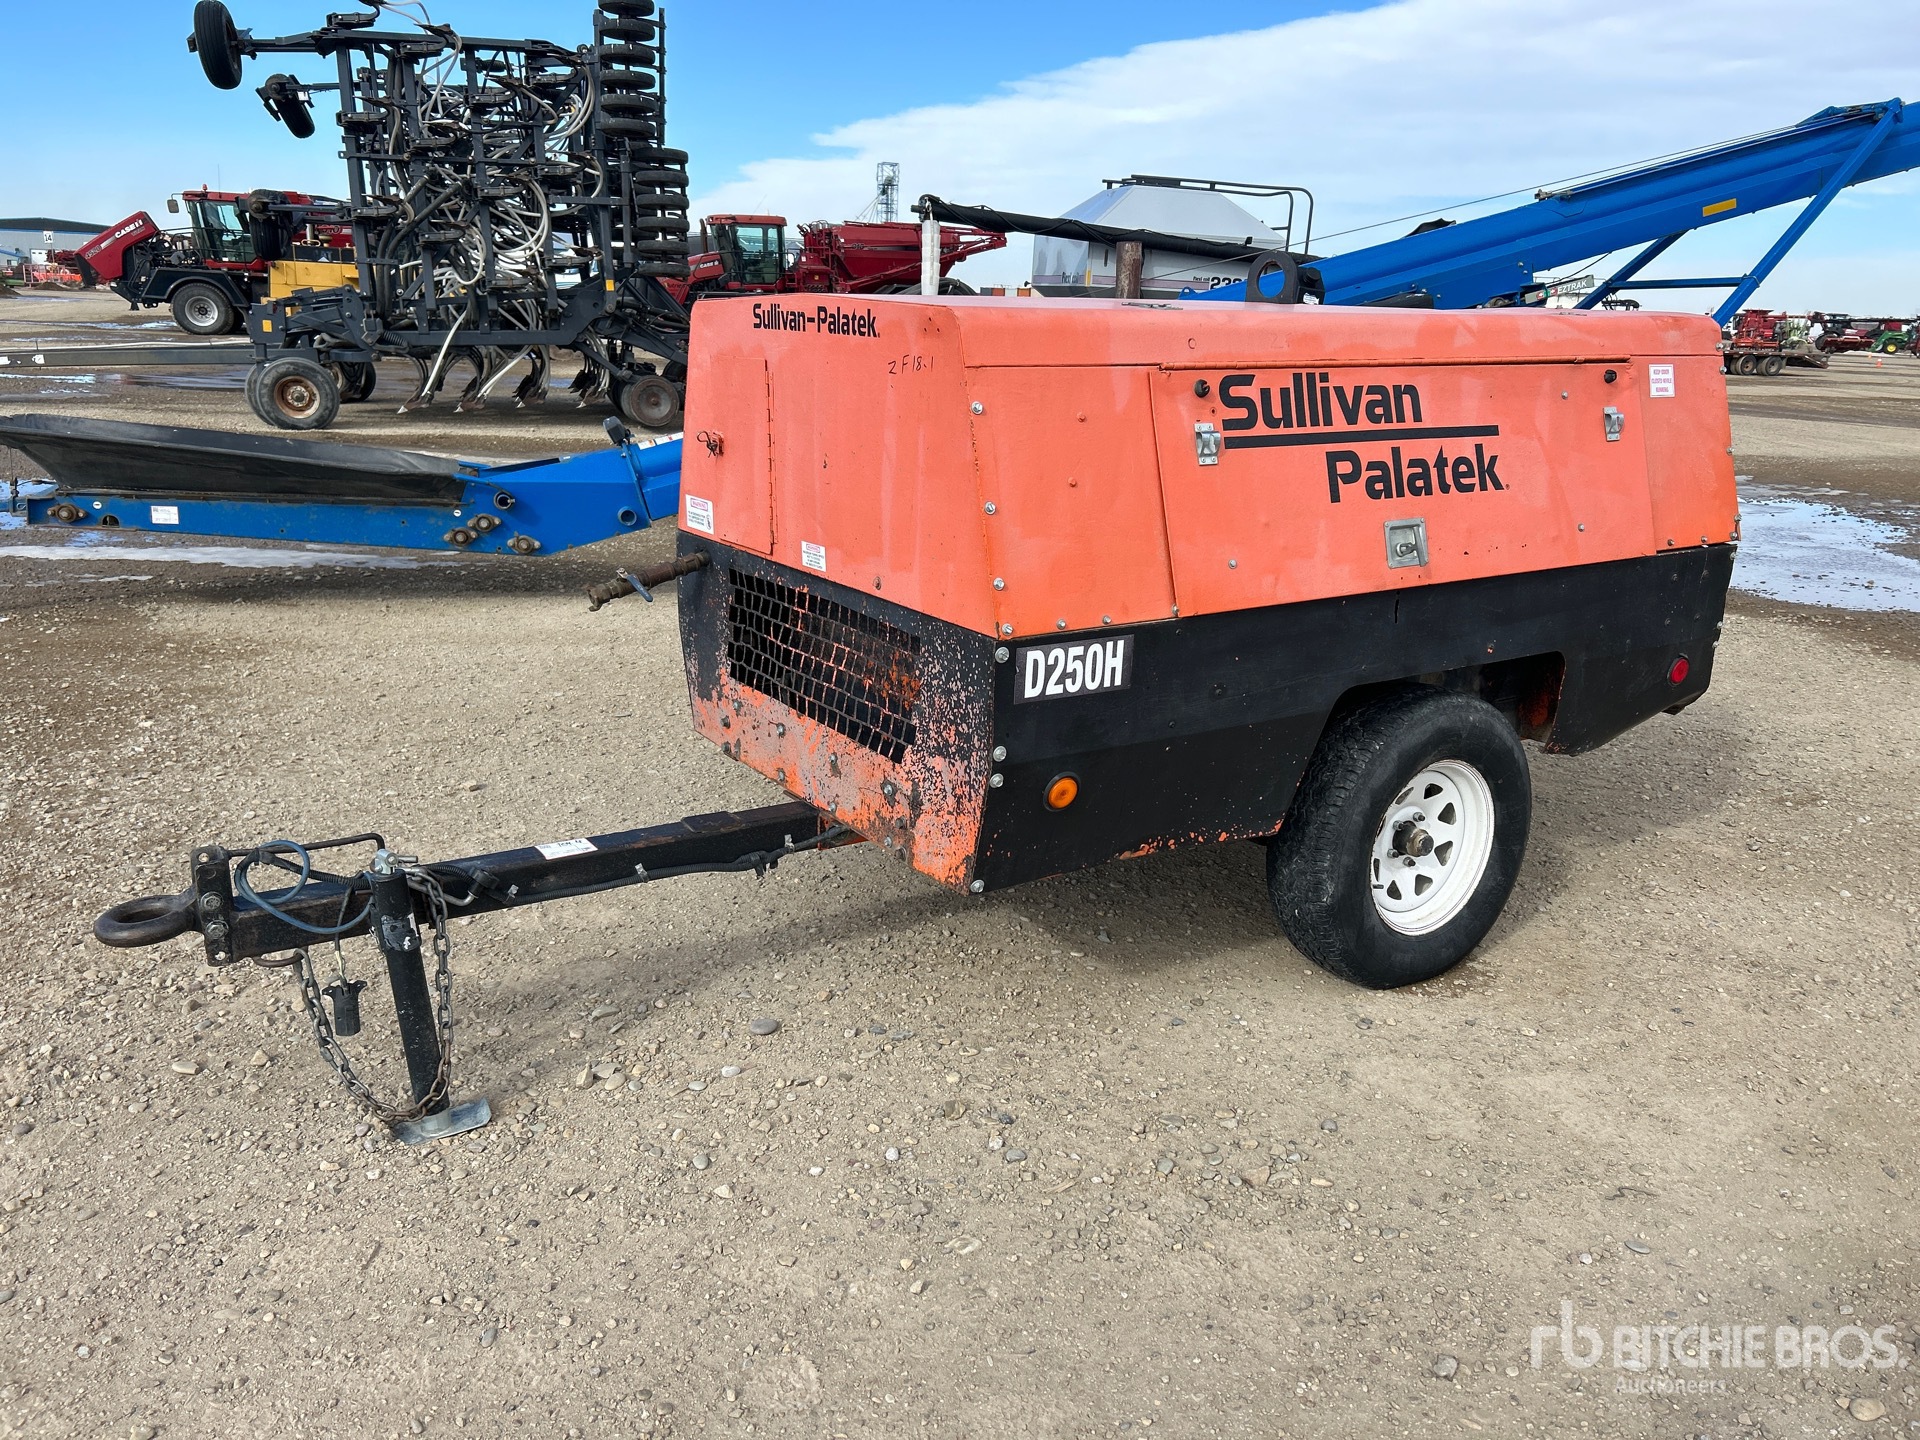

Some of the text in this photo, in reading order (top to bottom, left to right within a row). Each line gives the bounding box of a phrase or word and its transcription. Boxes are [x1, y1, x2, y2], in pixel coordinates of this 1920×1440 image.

[44, 233, 53, 242] 14
[115, 223, 138, 238] CASE
[1557, 280, 1588, 292] EZTRAK
[753, 303, 879, 338] Sullivan-Palatek
[1219, 372, 1422, 431] Sullivan
[1325, 443, 1505, 504] Palatek
[1024, 640, 1124, 698] D250H
